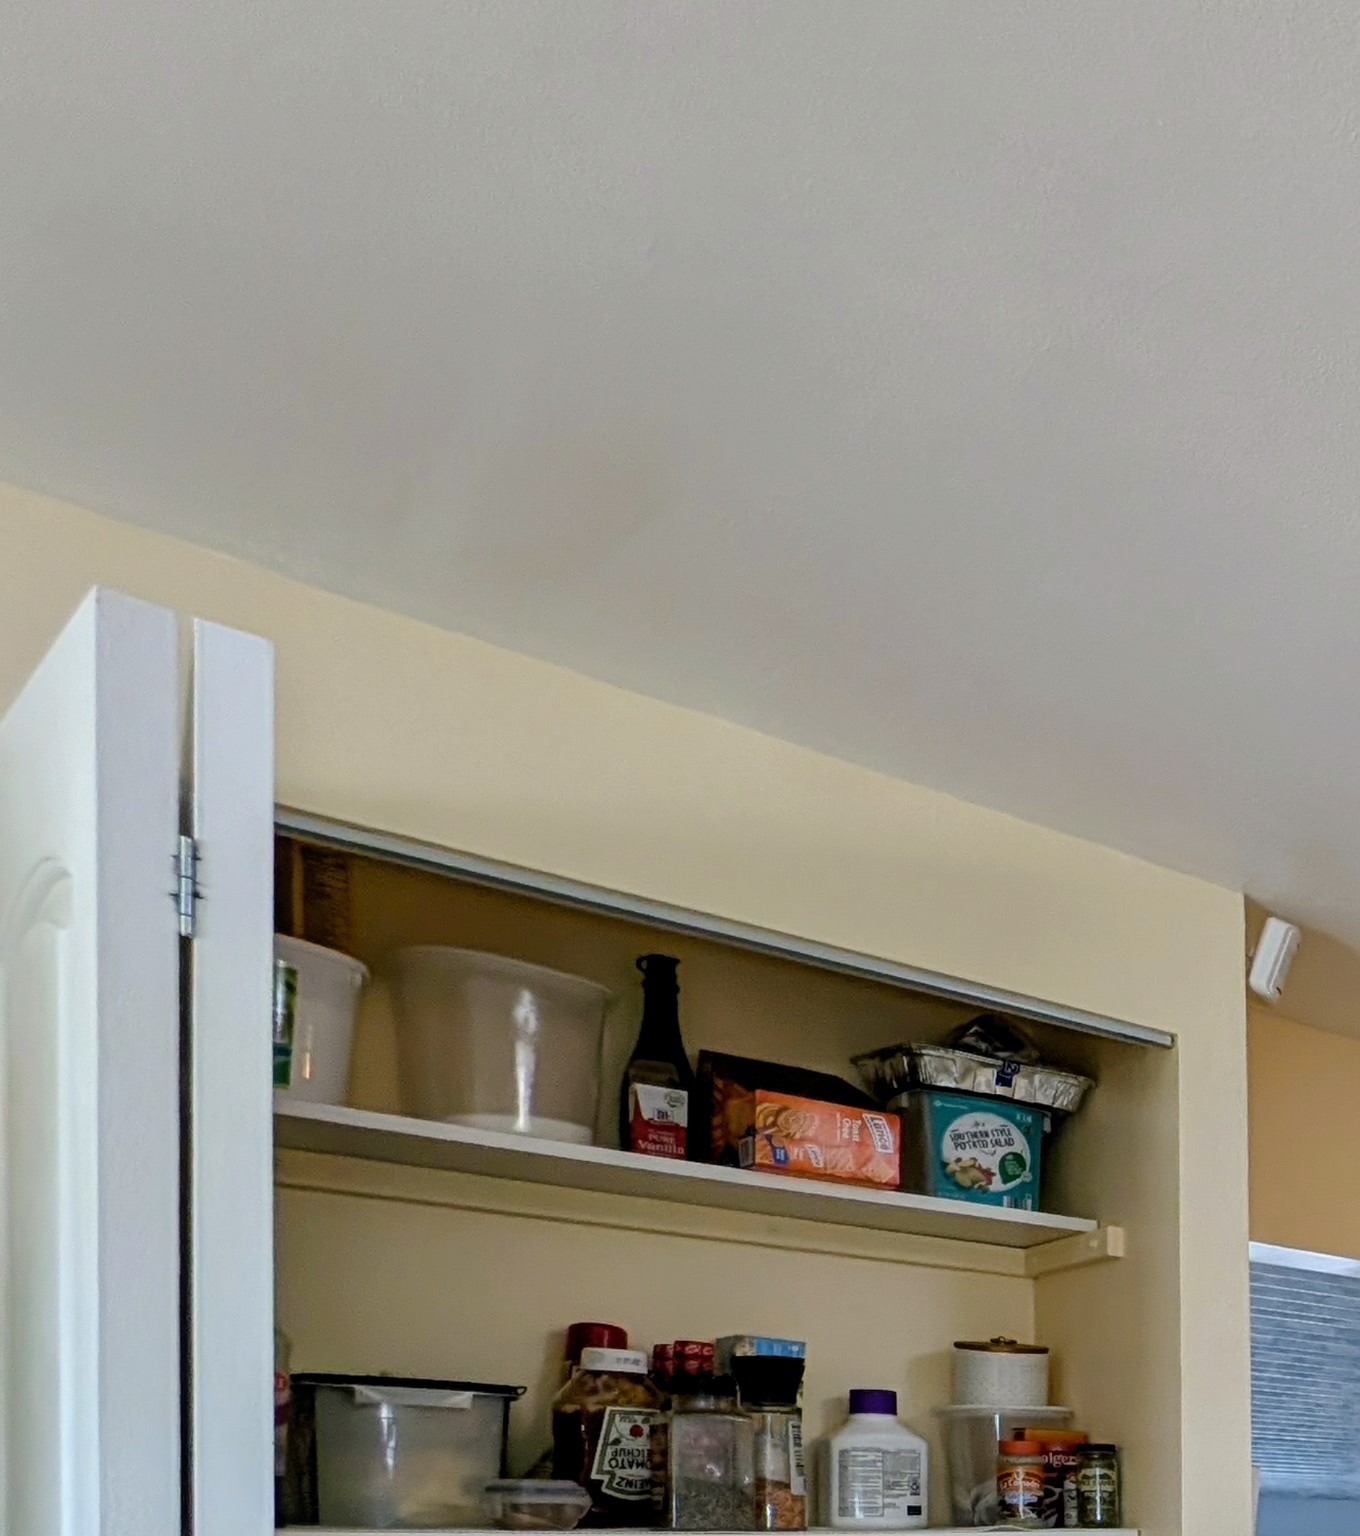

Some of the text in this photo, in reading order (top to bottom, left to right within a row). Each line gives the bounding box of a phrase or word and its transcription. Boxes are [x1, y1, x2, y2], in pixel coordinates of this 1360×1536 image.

[949, 1127, 1012, 1143] SOUTHERN STYLE
[954, 1136, 1015, 1151] POTATO SALAD
[608, 1458, 650, 1470] OMATO
[1041, 1451, 1079, 1468] olgers
